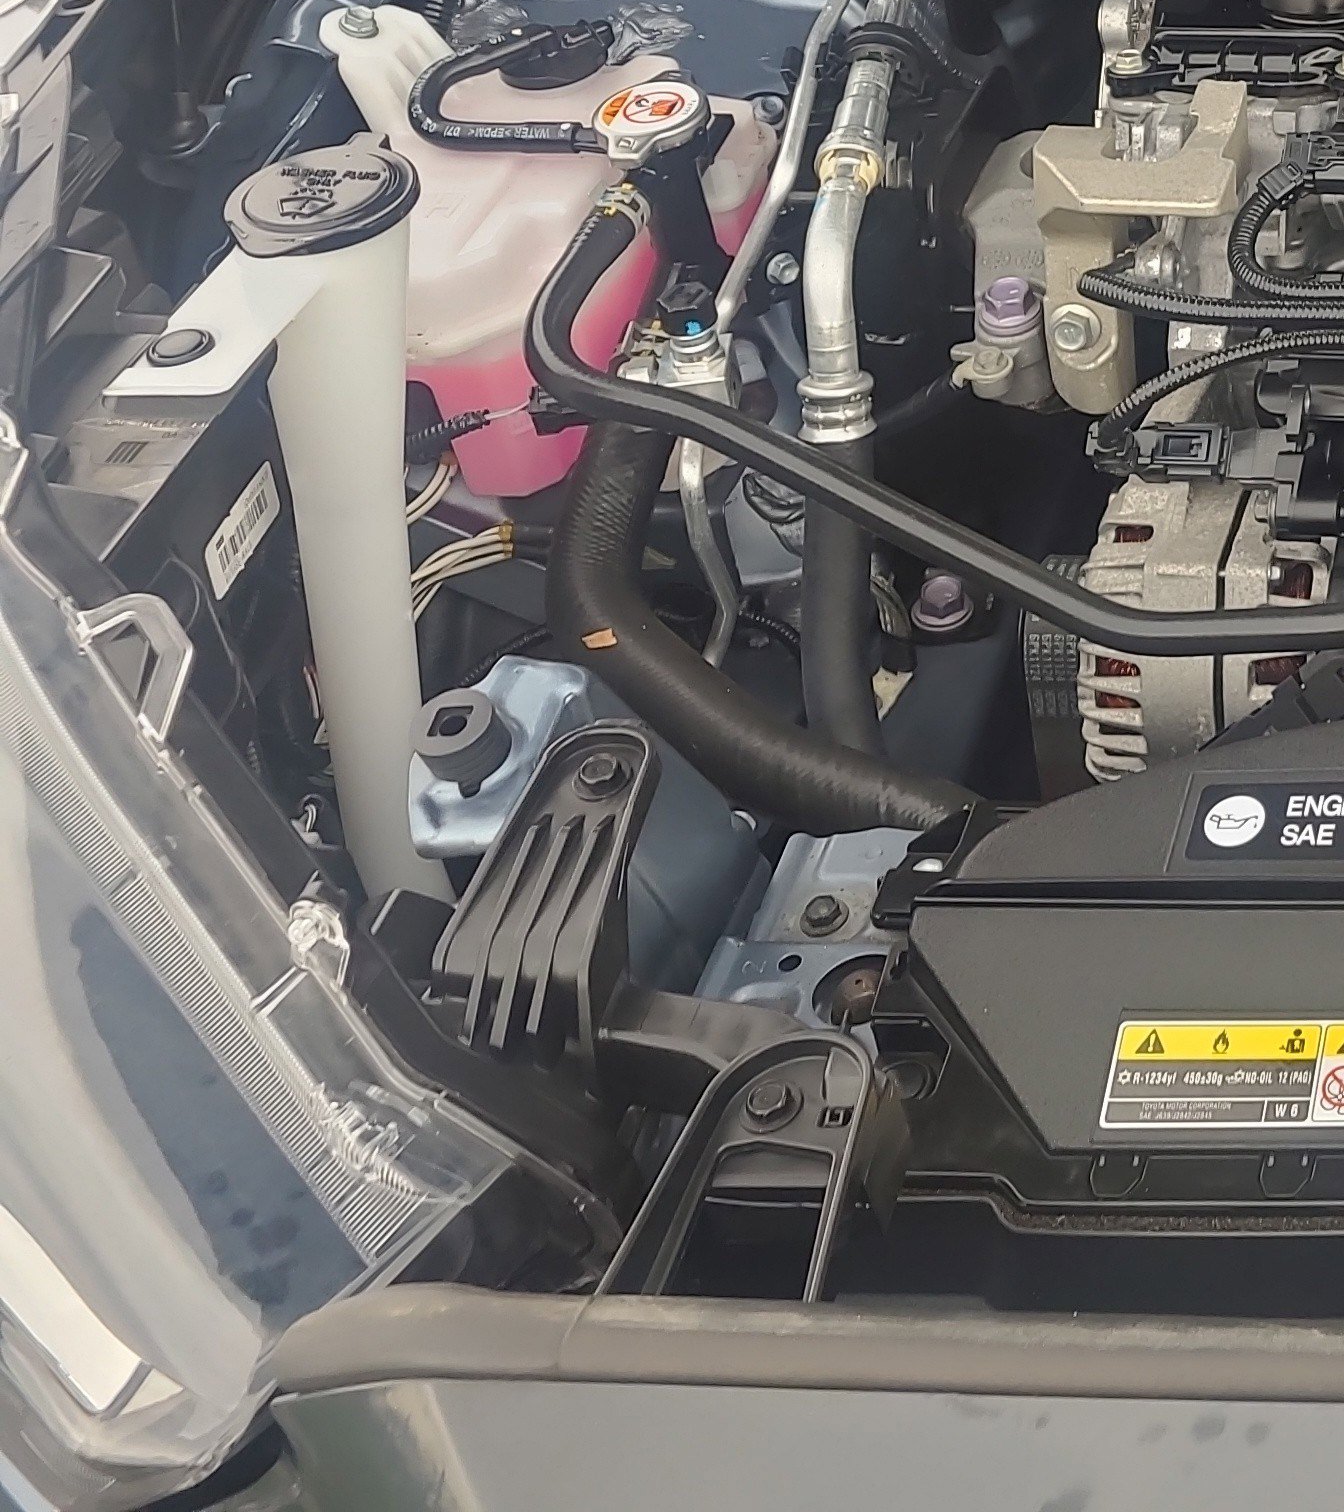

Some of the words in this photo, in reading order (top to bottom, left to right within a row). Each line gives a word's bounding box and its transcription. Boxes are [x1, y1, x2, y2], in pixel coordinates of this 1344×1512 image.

[513, 127, 551, 139] WATER
[1279, 823, 1336, 846] SAE
[1132, 1070, 1177, 1087] R-1234yf
[1278, 1070, 1288, 1084] 12
[1141, 1101, 1165, 1111] TOYOTA
[1165, 1101, 1188, 1111] MOTOR
[1188, 1100, 1232, 1111] CORPORATION
[1274, 1103, 1288, 1118] W
